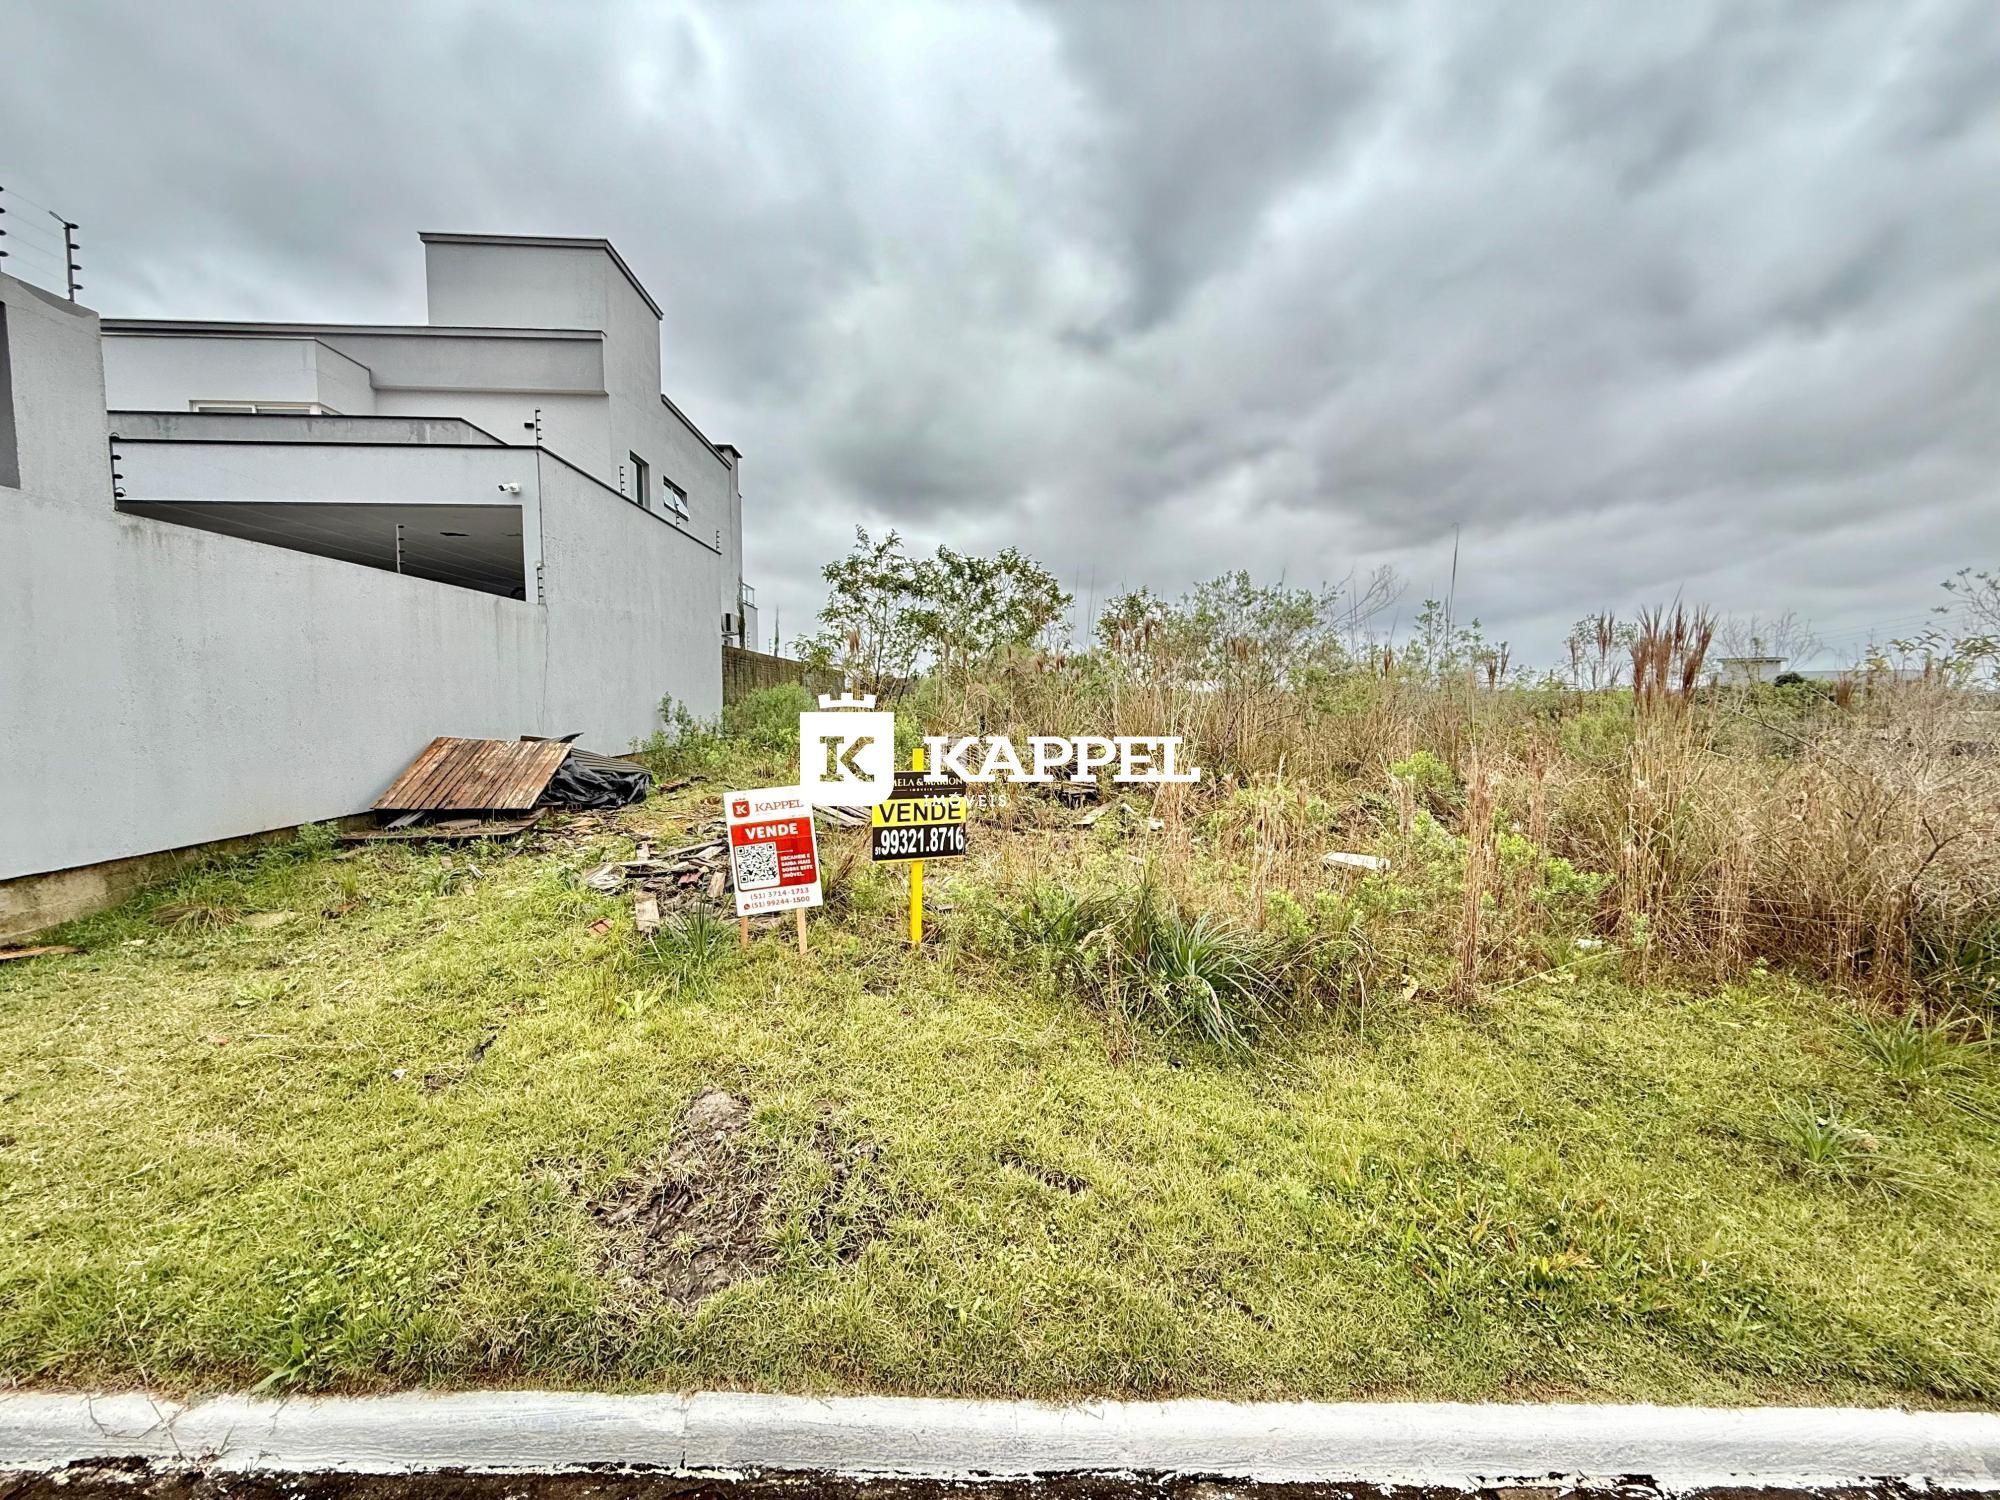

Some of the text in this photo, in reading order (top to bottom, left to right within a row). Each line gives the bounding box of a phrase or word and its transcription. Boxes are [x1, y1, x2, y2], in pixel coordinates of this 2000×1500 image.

[735, 804, 747, 815] K
[755, 800, 804, 812] KAPPEL
[879, 802, 962, 823] VENDE
[745, 823, 799, 840] VENDE
[880, 826, 964, 855] 99321.8716
[768, 887, 810, 898] 3714-1713
[751, 901, 766, 909] (51)
